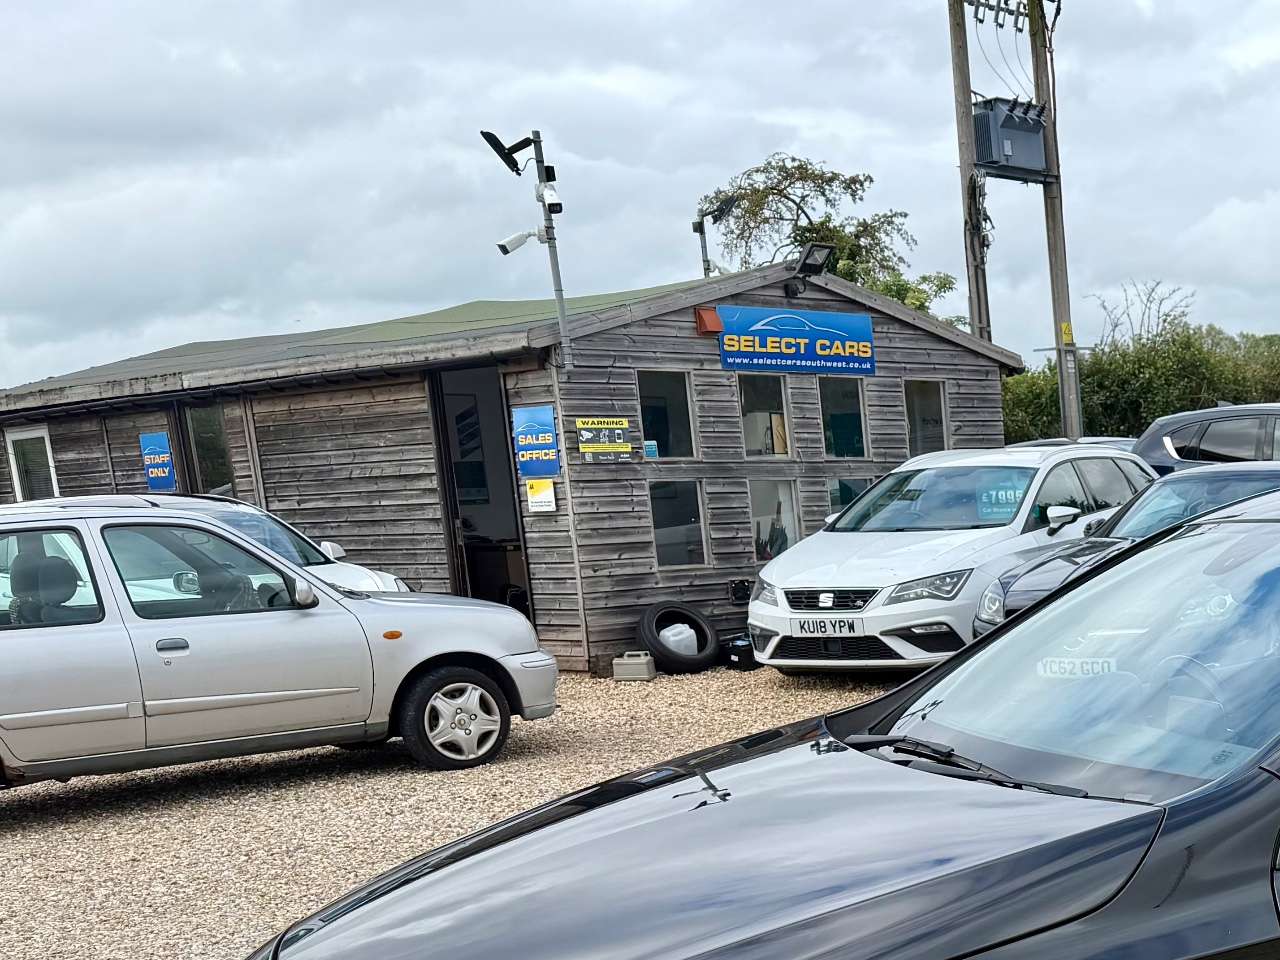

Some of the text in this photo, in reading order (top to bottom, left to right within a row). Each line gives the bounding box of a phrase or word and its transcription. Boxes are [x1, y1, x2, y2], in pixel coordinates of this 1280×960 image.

[723, 335, 872, 358] SELECT CARS
[727, 356, 871, 369] www.selectcarssouthwest.co.uk
[518, 433, 553, 445] SALES
[144, 454, 170, 464] STAFF
[519, 449, 557, 461] OFFICE
[149, 467, 169, 478] ONLY
[799, 620, 855, 634] KU18 YPW
